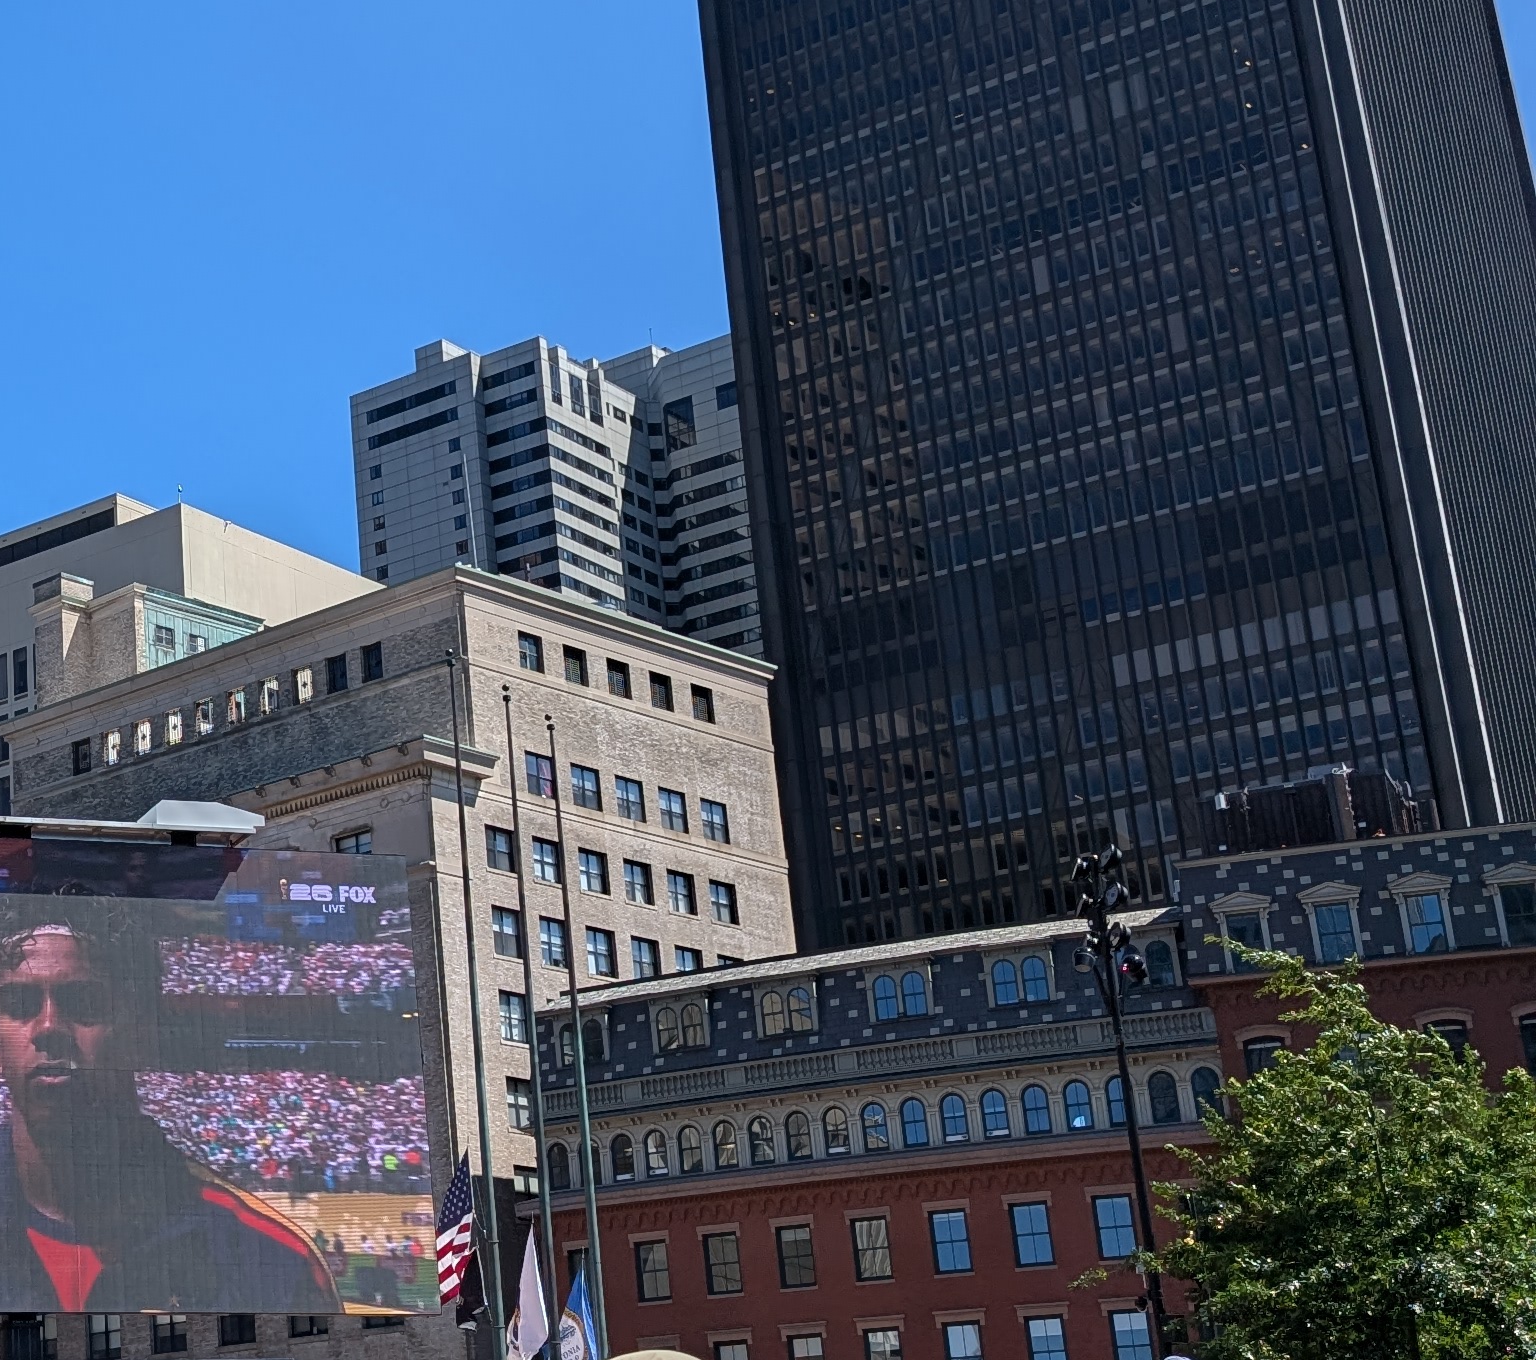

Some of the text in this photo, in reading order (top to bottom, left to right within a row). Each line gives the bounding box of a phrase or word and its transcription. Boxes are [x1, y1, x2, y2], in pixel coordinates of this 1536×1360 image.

[290, 883, 377, 904] 26 FOX
[322, 903, 346, 914] LIVE
